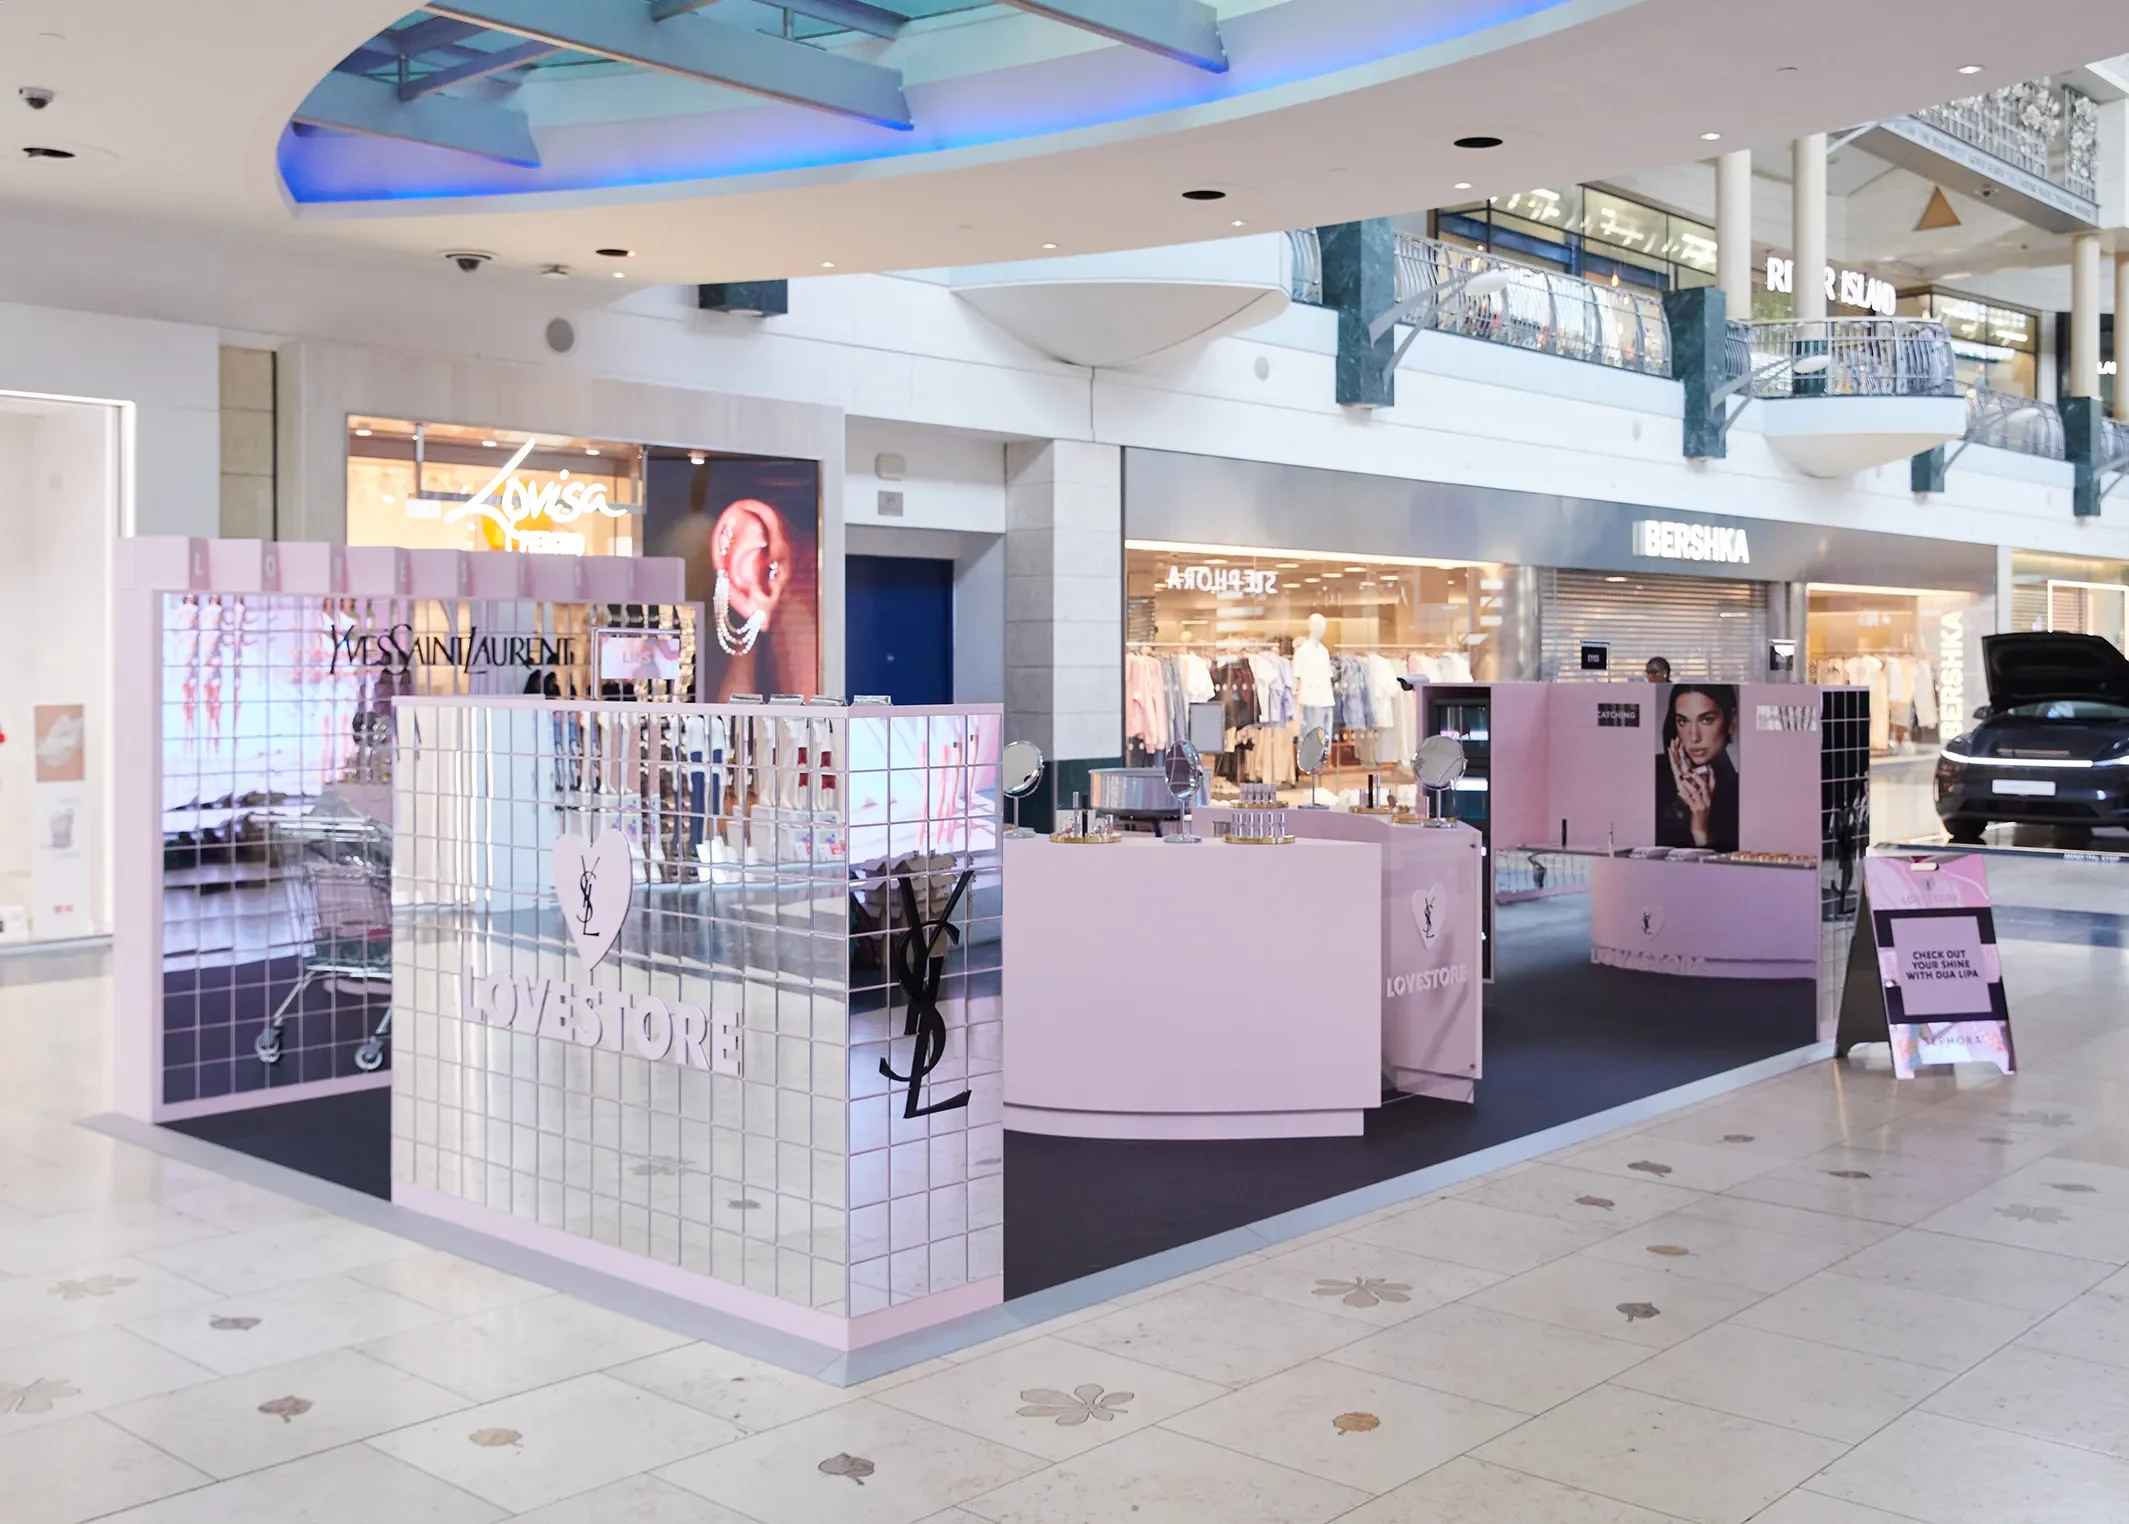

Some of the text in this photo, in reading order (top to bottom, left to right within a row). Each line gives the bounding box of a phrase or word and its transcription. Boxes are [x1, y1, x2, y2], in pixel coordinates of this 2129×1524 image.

[1767, 257, 1897, 316] RIR ISLAND
[444, 438, 627, 552] Lovisa
[1641, 520, 1750, 564] BERSHKA
[1940, 610, 1963, 740] BERSHKA
[1906, 970, 1979, 980] WITH DUA LIPA
[1912, 950, 1966, 960] CHECK OUT
[1912, 960, 1970, 970] YOUR SHINE
[1386, 964, 1467, 998] LOVESTORE
[461, 965, 742, 1077] LOVESTORE
